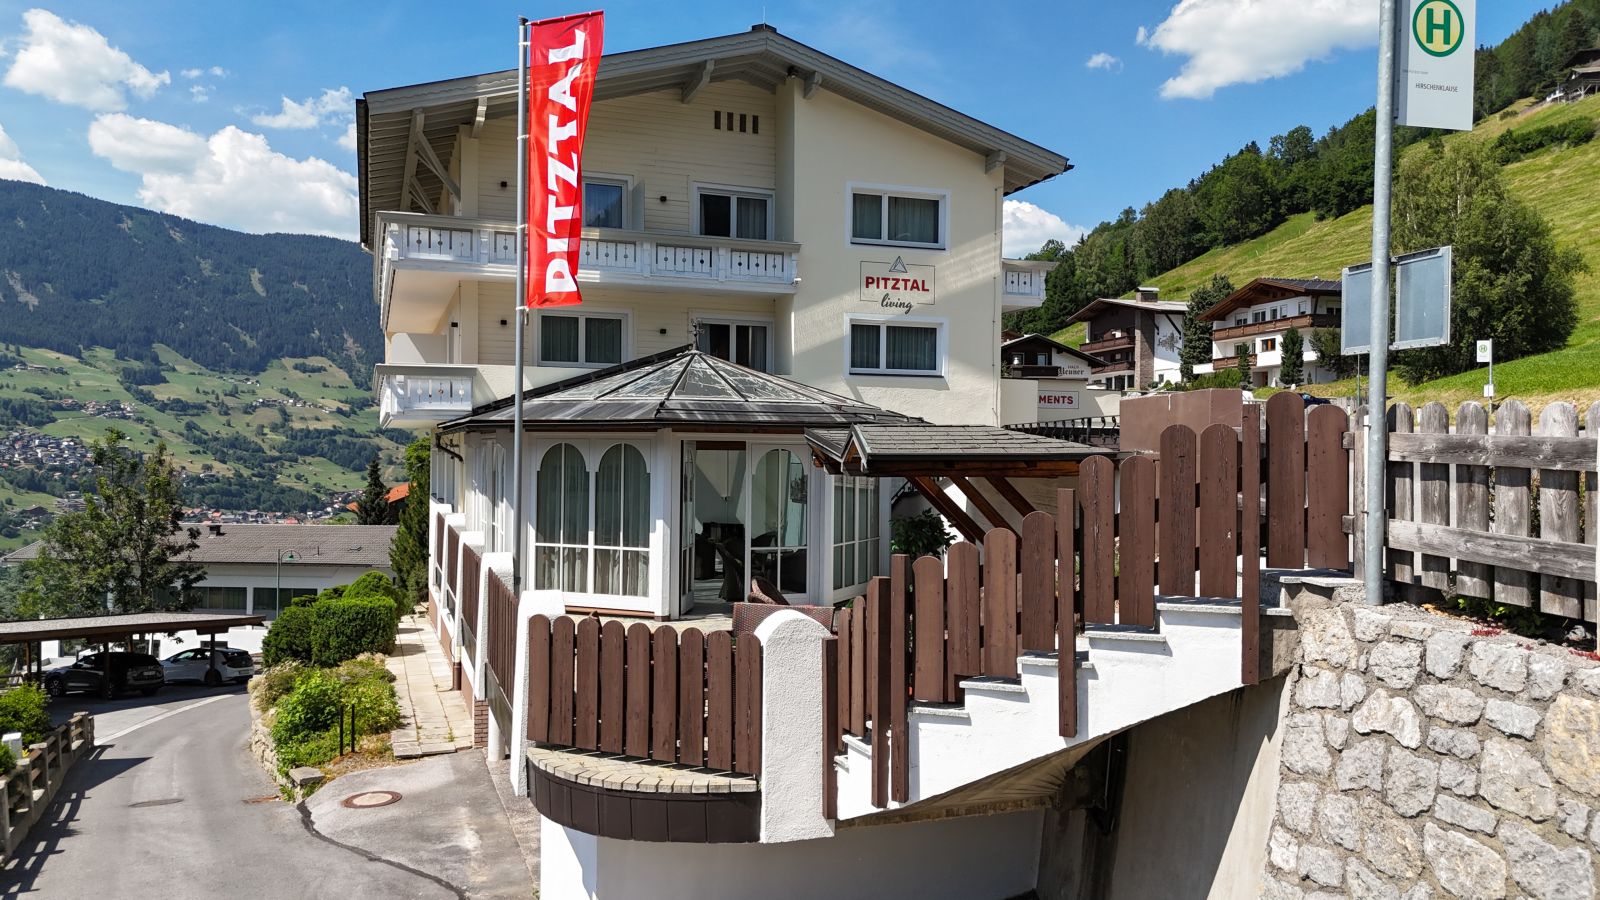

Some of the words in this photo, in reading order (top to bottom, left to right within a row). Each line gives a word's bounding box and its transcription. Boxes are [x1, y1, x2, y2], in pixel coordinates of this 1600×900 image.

[1426, 8, 1451, 45] H
[1415, 83, 1459, 92] HIRSCHENKLAUSE
[545, 29, 586, 294] PITZTAL
[865, 276, 930, 292] PITZTAL
[881, 293, 914, 315] living
[1038, 395, 1074, 404] MENTS
